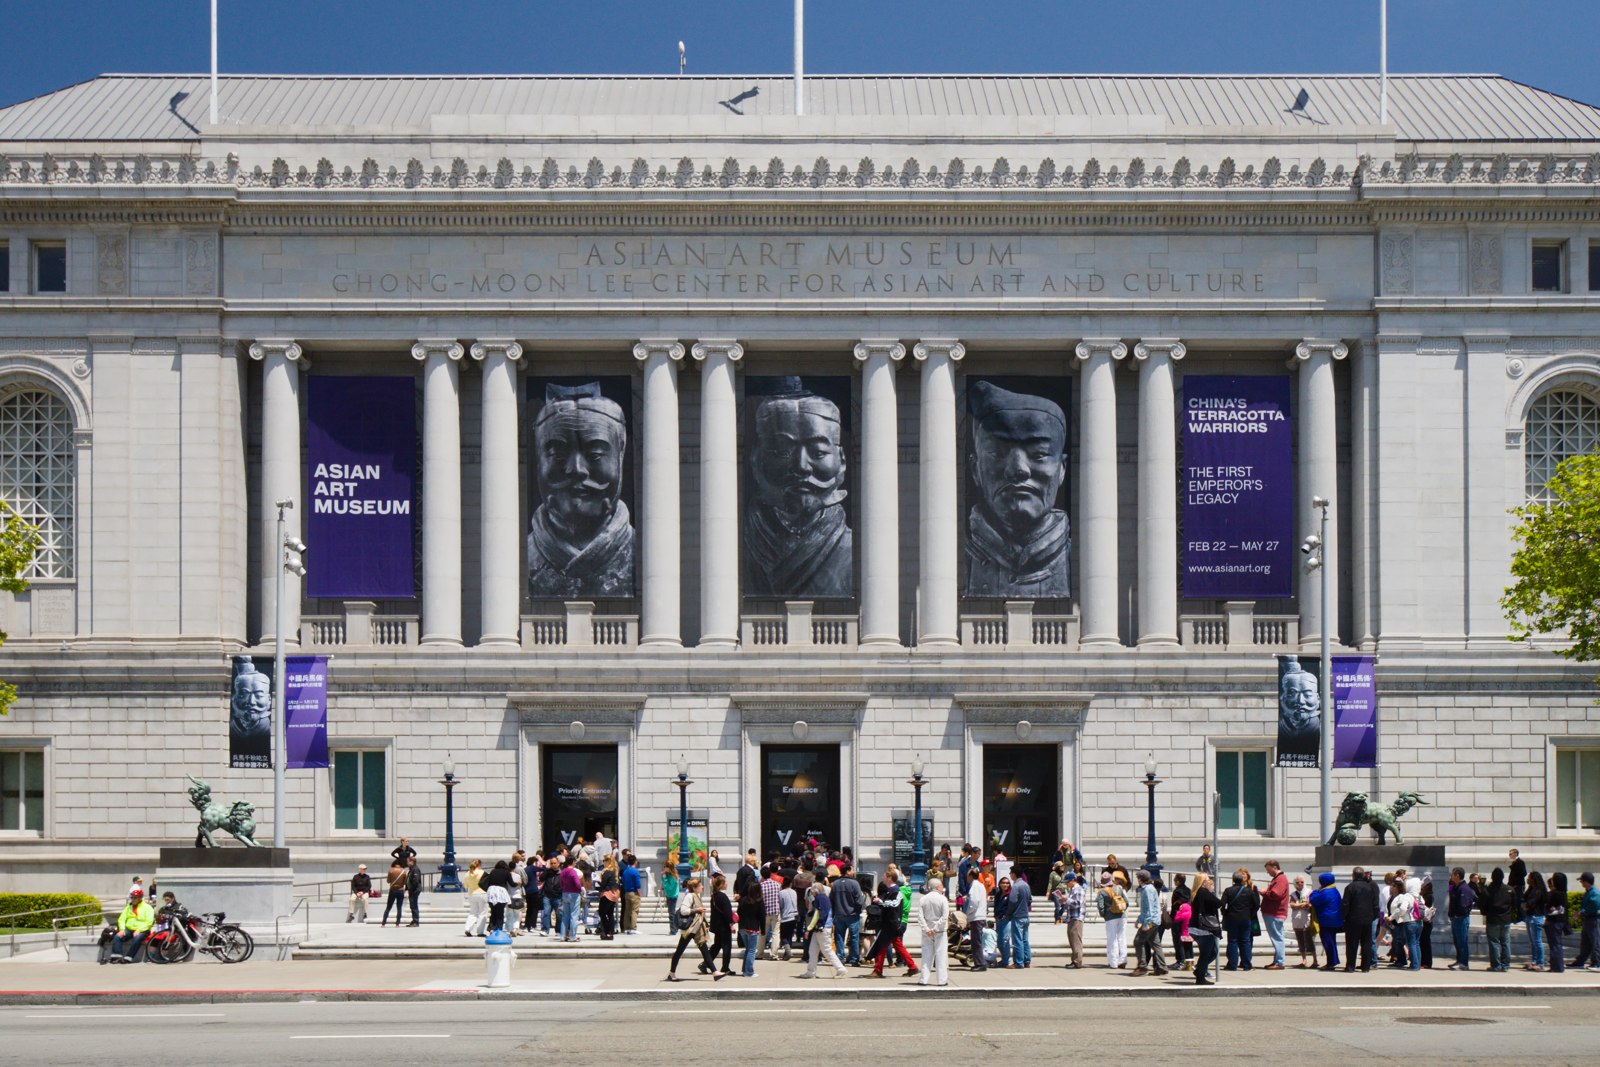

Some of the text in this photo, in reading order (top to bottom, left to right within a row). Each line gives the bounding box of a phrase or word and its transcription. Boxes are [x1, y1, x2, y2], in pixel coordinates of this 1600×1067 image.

[585, 241, 1015, 267] ASIAN ART MUSEUM
[332, 273, 1265, 293] CHONG-MOON LEE CENTER FOR ASIAN ART AND CULTURE
[1188, 398, 1247, 409] CHINA'S
[1188, 410, 1285, 421] TERRACOTTA
[1188, 422, 1268, 433] WARRIORS
[314, 463, 380, 480] ASIAN
[1188, 466, 1253, 478] THE FIRST
[314, 481, 358, 497] ART
[1188, 480, 1263, 492] EMPEROR'S
[1188, 493, 1239, 505] LEGACY
[315, 499, 410, 515] MUSEUM
[1188, 542, 1210, 551] FEB
[1212, 541, 1226, 551] 22
[1241, 541, 1263, 551] MAY
[1266, 541, 1279, 551] 27
[1188, 563, 1271, 575] www.asianart.org
[782, 786, 818, 794] Entrance
[1016, 787, 1031, 795] Only
